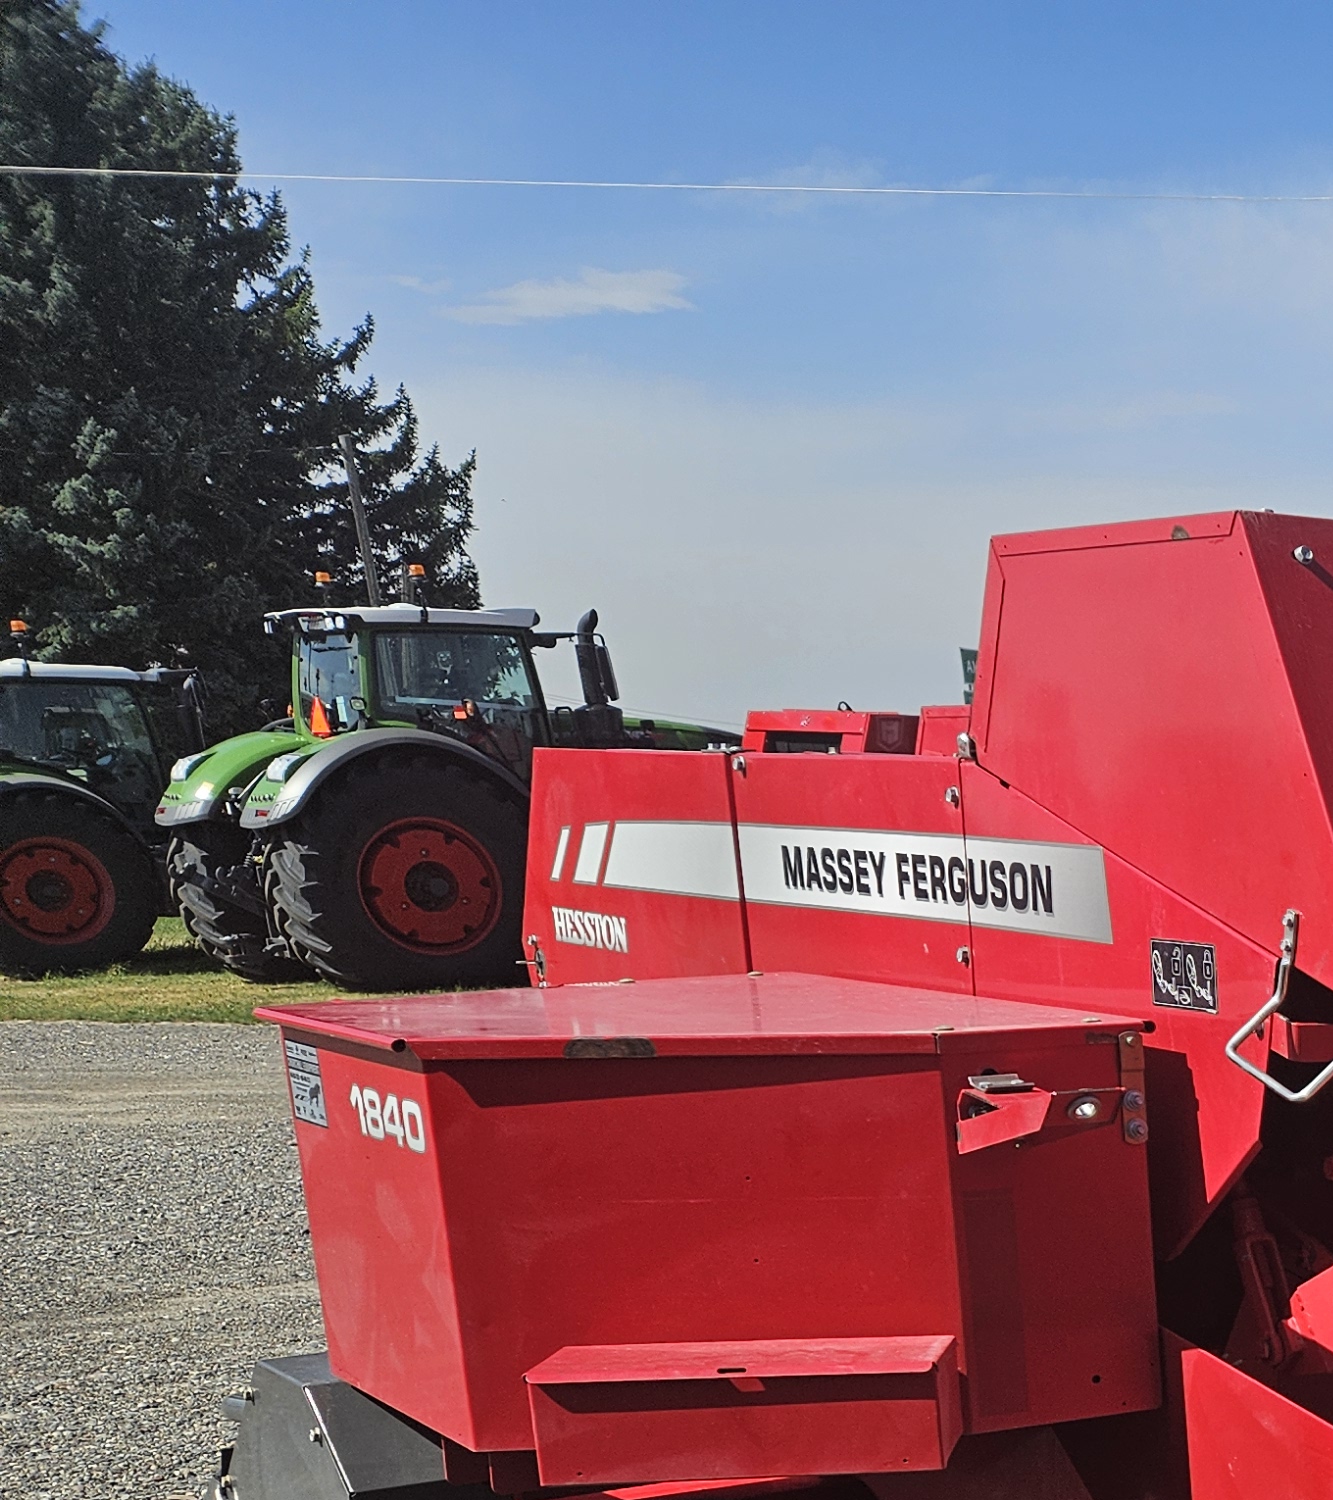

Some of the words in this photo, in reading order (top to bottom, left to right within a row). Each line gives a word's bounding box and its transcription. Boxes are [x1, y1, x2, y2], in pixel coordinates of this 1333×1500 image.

[781, 845, 886, 897] MASSEY
[896, 853, 1054, 916] FERGUSON
[552, 906, 628, 953] HESSTON
[350, 1083, 426, 1153] 1840
